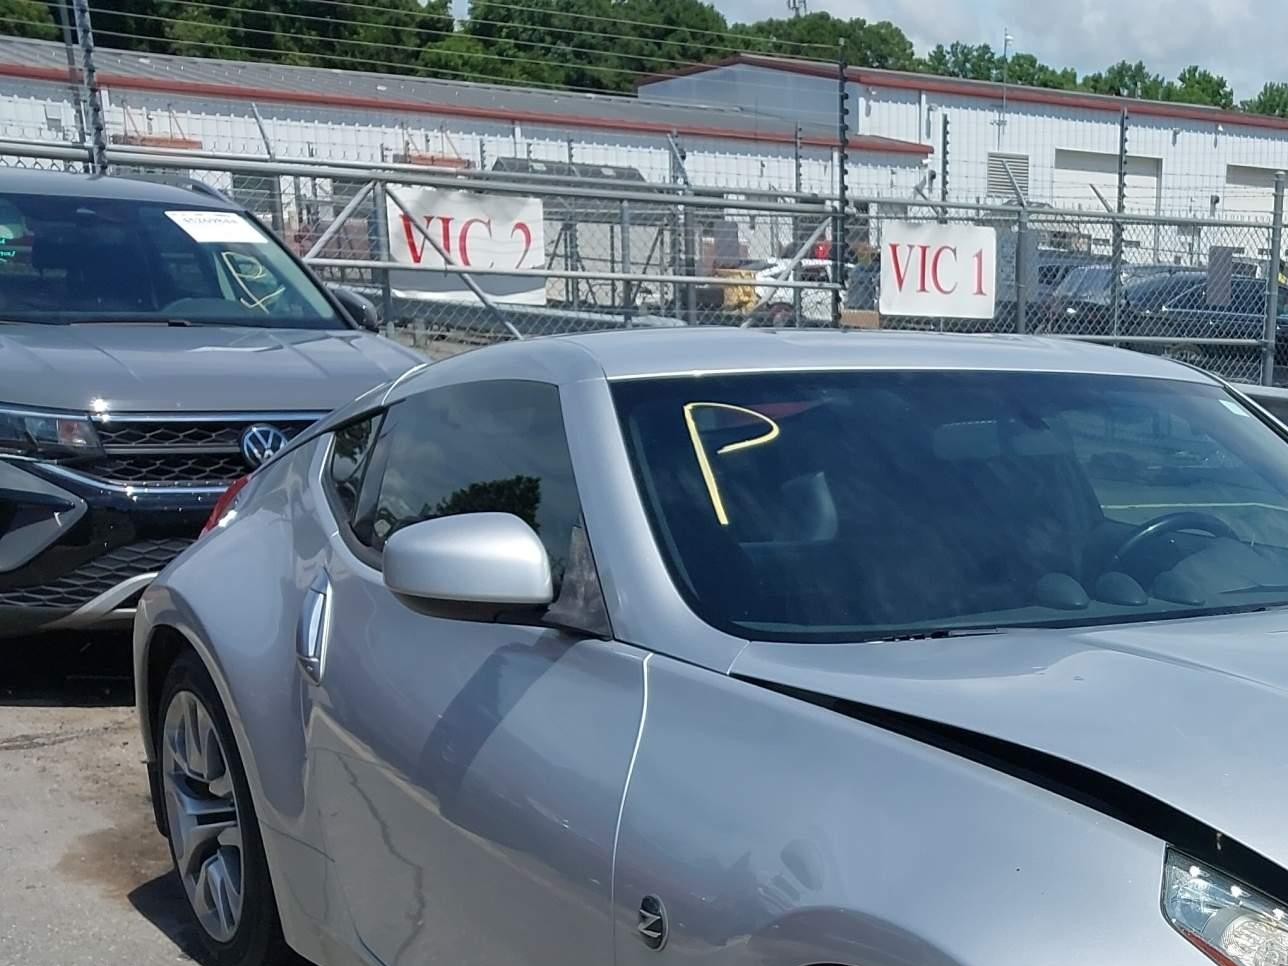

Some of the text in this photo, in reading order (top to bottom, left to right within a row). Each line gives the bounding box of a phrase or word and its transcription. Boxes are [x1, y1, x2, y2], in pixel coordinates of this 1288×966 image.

[400, 214, 531, 269] VIC 2
[889, 243, 987, 296] VIC 1
[683, 402, 779, 525] P
